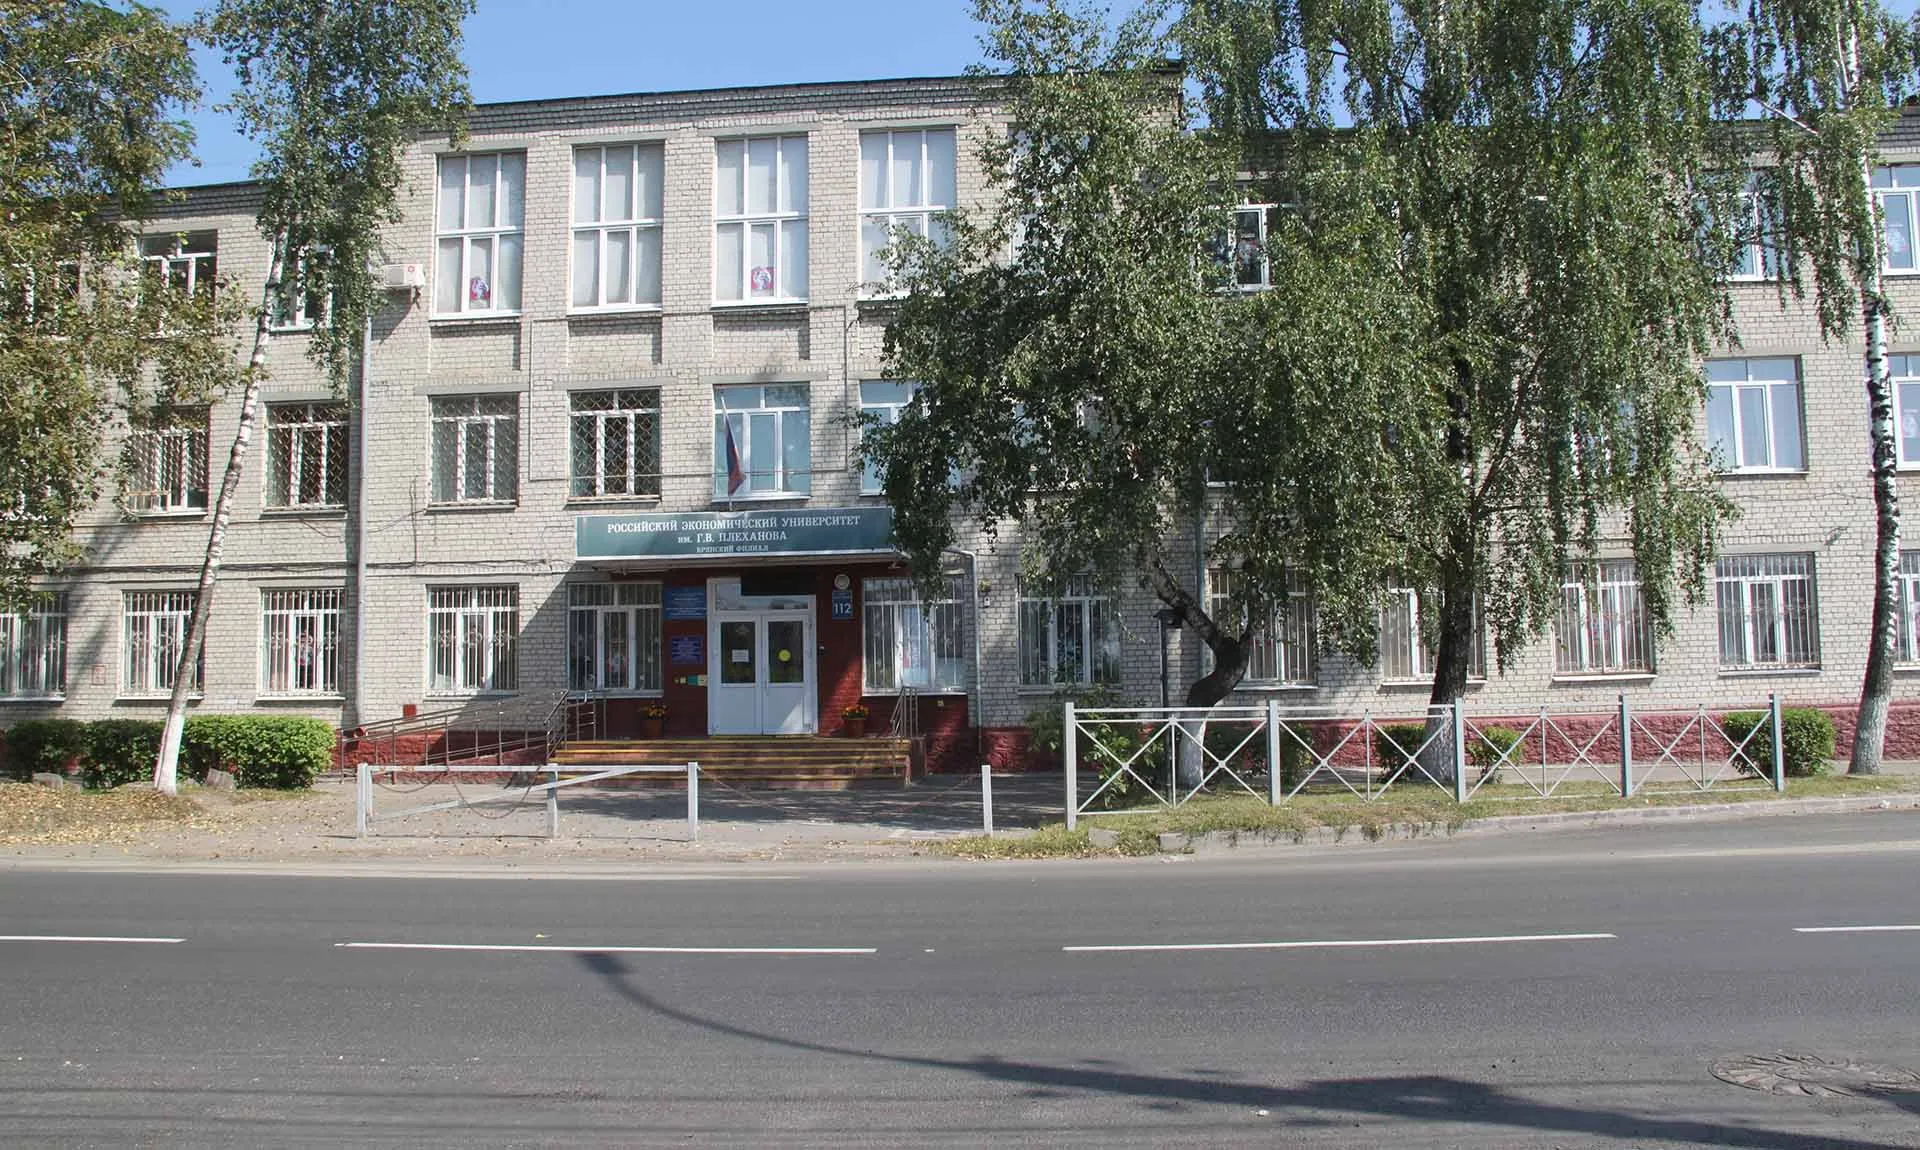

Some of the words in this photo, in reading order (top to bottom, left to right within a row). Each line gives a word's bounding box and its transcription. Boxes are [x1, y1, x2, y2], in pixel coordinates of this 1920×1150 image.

[607, 520, 677, 533] РОССИЙСКИЙ
[682, 517, 777, 530] ЭКОНОМИЧЕСКИЙ
[782, 515, 860, 528] УНИВЕРСИТЕТ
[719, 531, 787, 542] ПЛЕХАНОВА
[834, 602, 852, 614] 112
